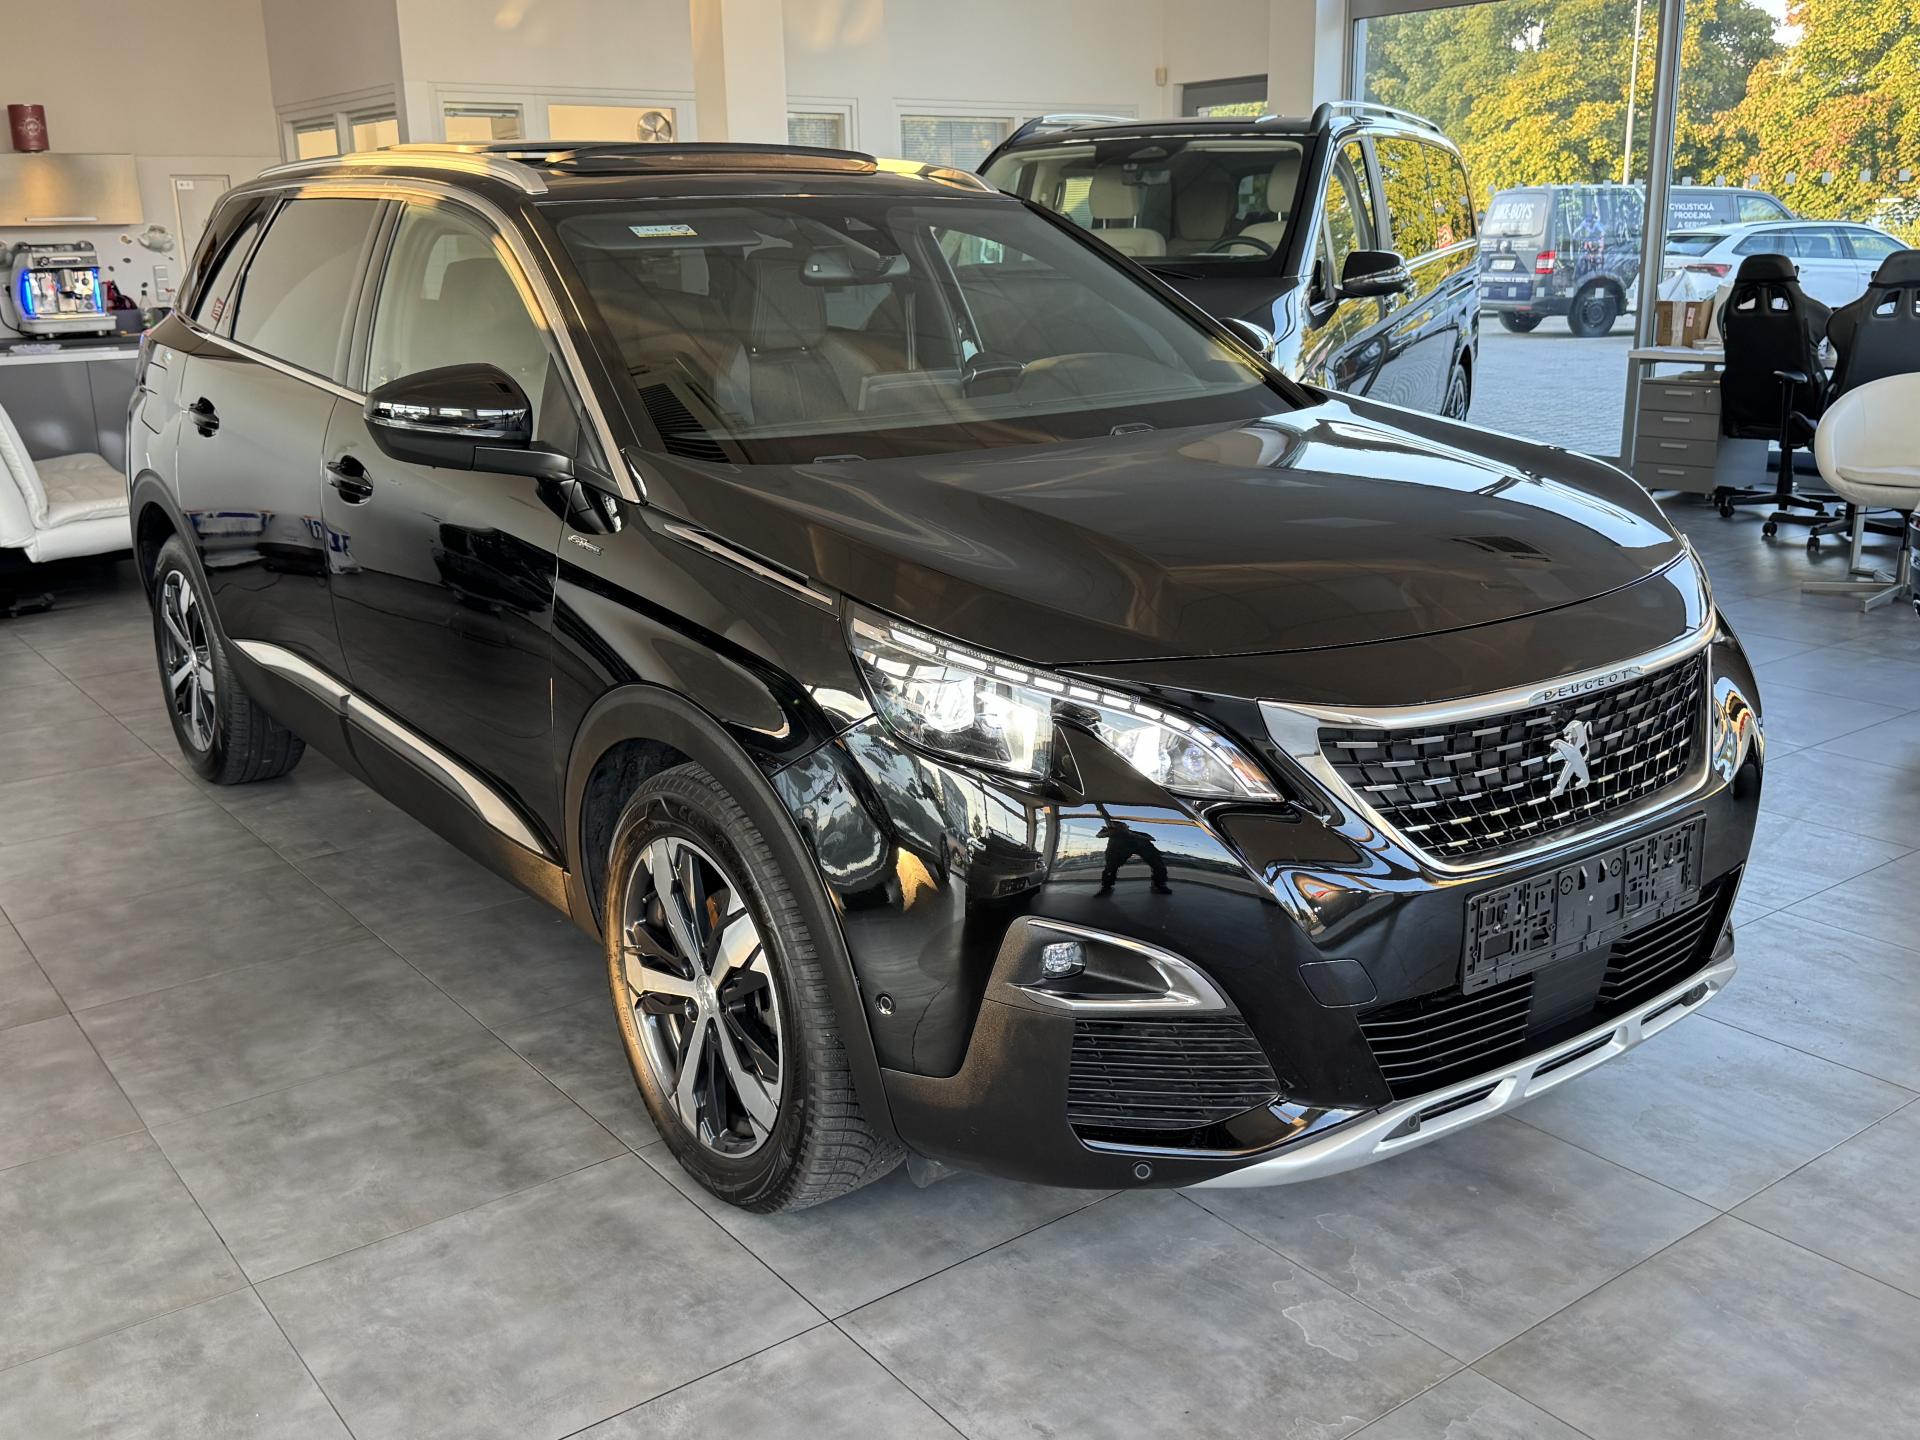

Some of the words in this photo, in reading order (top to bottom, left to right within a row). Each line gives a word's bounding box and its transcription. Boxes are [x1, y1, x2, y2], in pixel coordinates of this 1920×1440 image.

[1669, 201, 1714, 211] CYKLISTICKÁ
[1674, 211, 1712, 219] PRODEJNA
[1544, 670, 1630, 701] PEUGEOT
